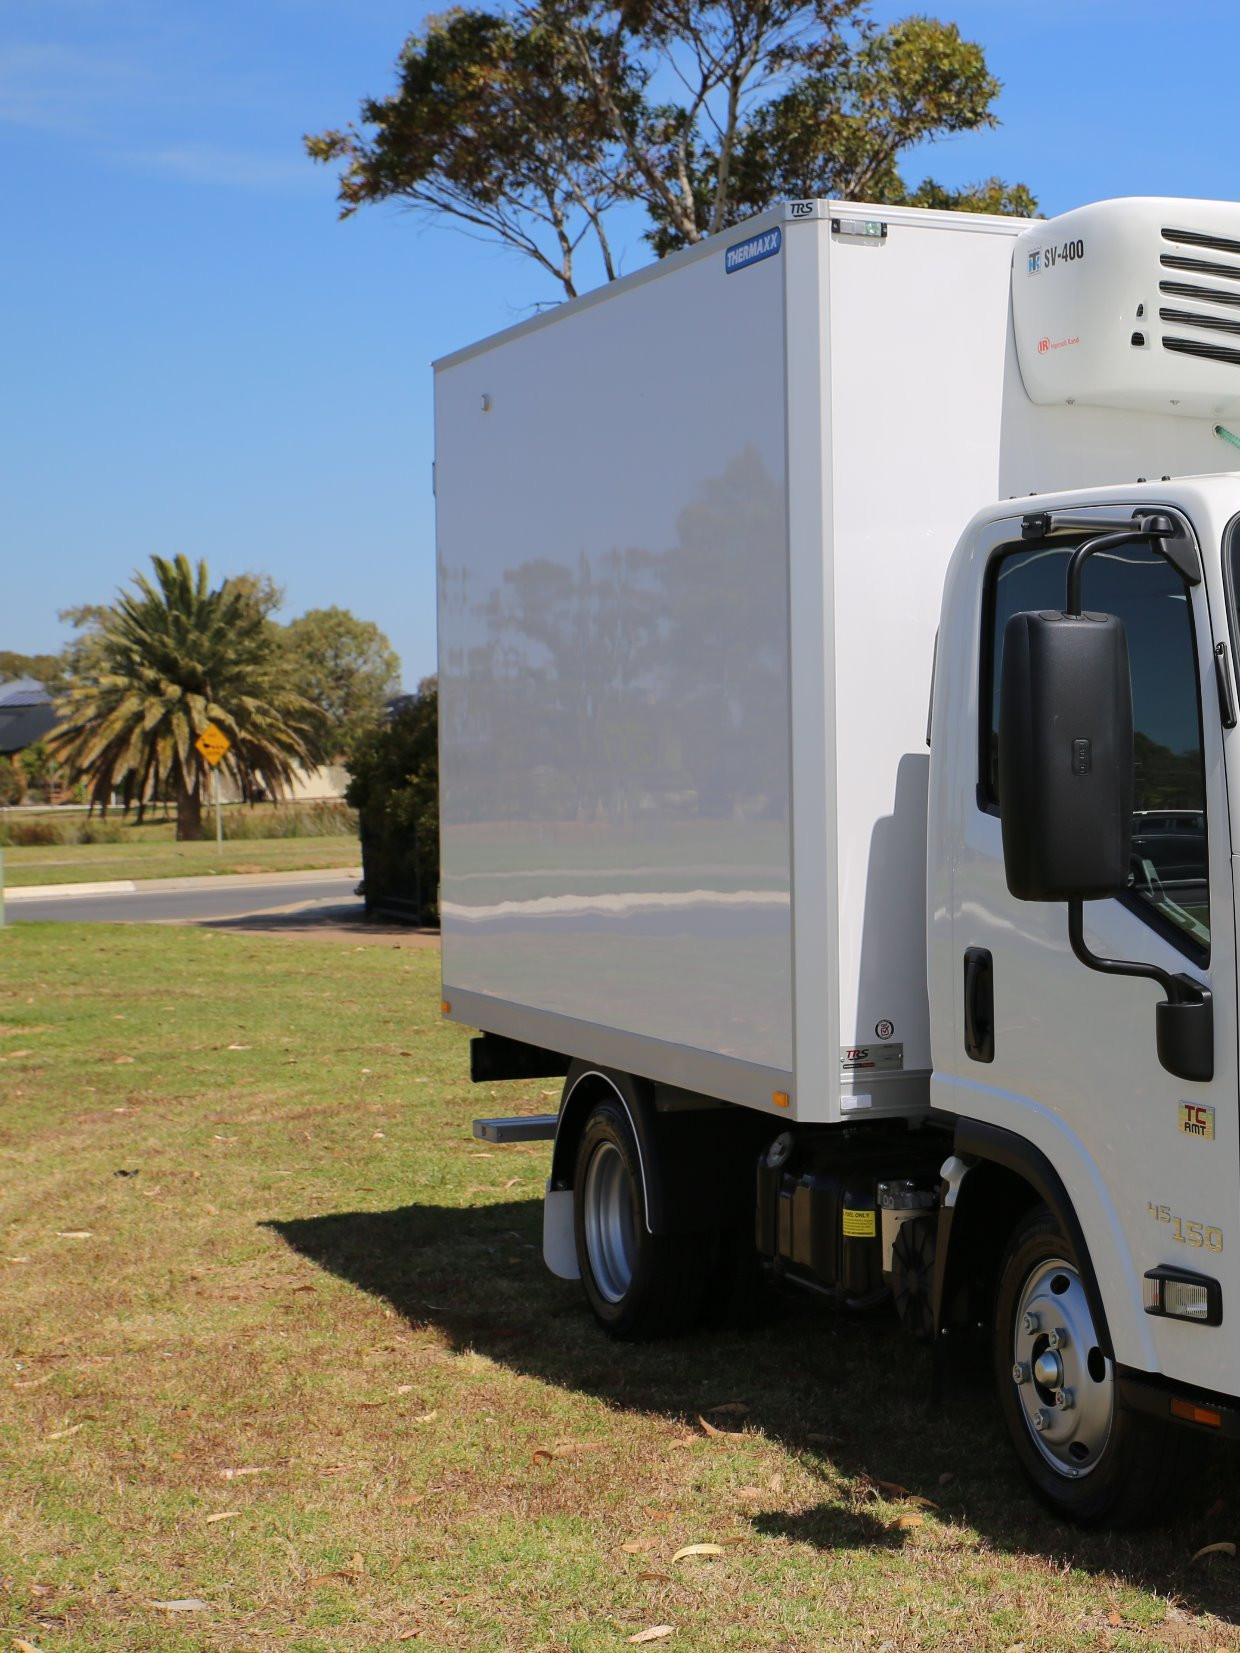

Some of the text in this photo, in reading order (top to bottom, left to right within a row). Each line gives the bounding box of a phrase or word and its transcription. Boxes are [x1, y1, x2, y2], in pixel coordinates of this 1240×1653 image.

[790, 202, 813, 218] TRS
[726, 233, 779, 268] THERMAXX
[1044, 239, 1084, 269] SV-400
[846, 1049, 869, 1060] TRS
[1185, 1104, 1207, 1125] TC
[1184, 1122, 1207, 1136] AMT
[1147, 1201, 1224, 1254] 45 150
